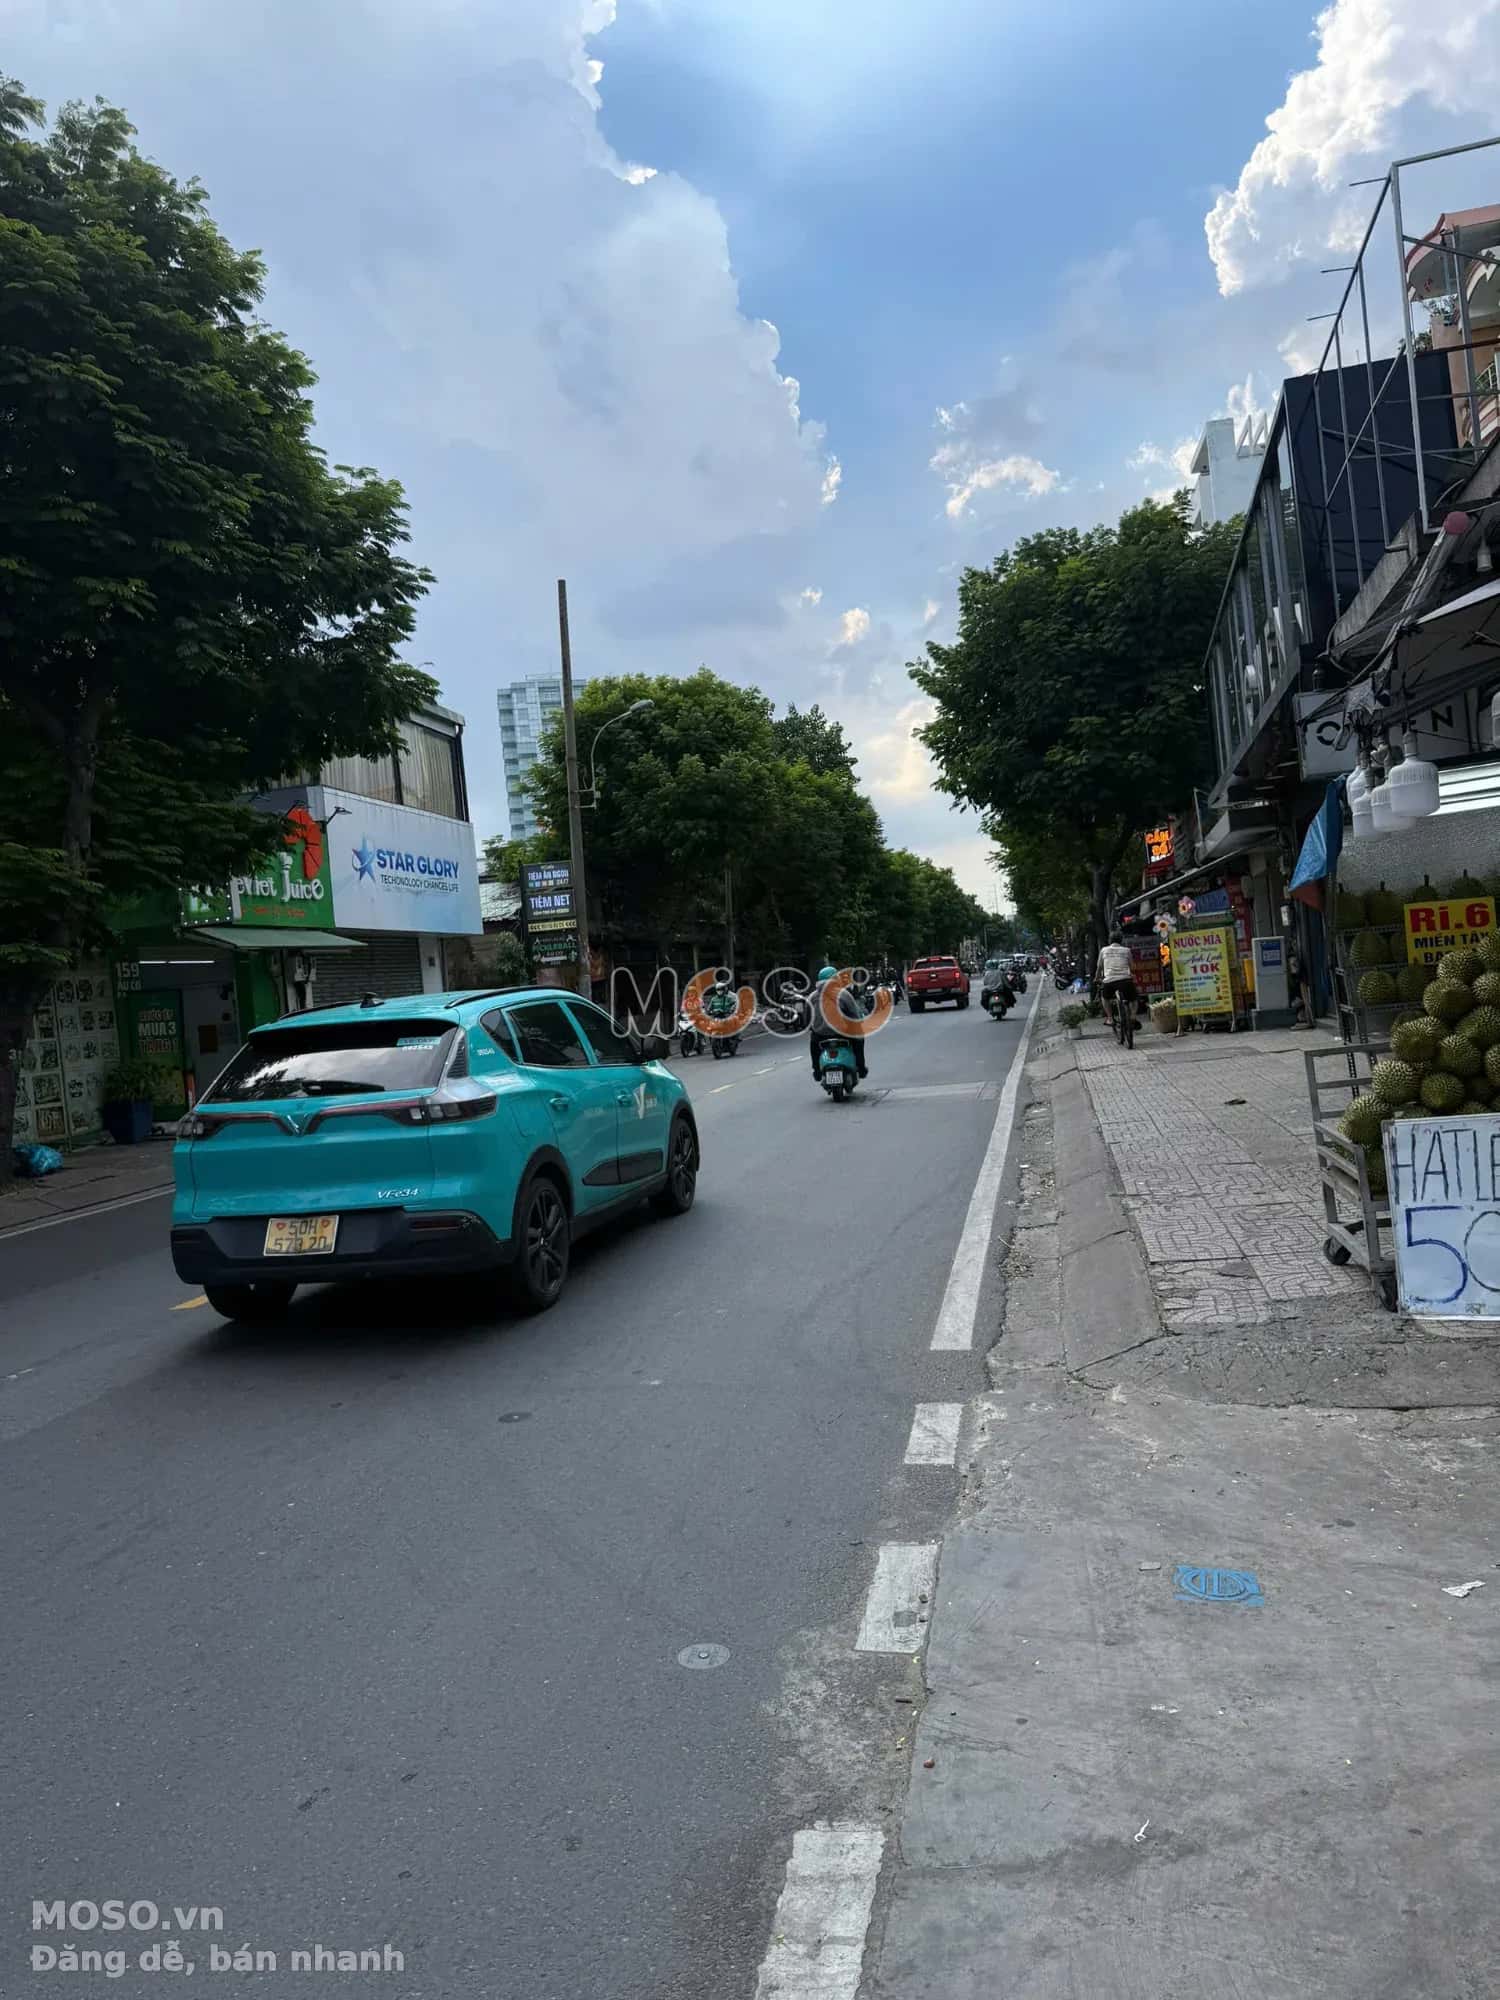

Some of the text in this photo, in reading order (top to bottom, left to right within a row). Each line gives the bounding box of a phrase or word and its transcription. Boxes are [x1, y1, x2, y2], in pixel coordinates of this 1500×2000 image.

[376, 849, 459, 879] STAR GLORY
[553, 894, 570, 907] NET
[114, 961, 140, 977] 159
[1191, 963, 1220, 974] 10K
